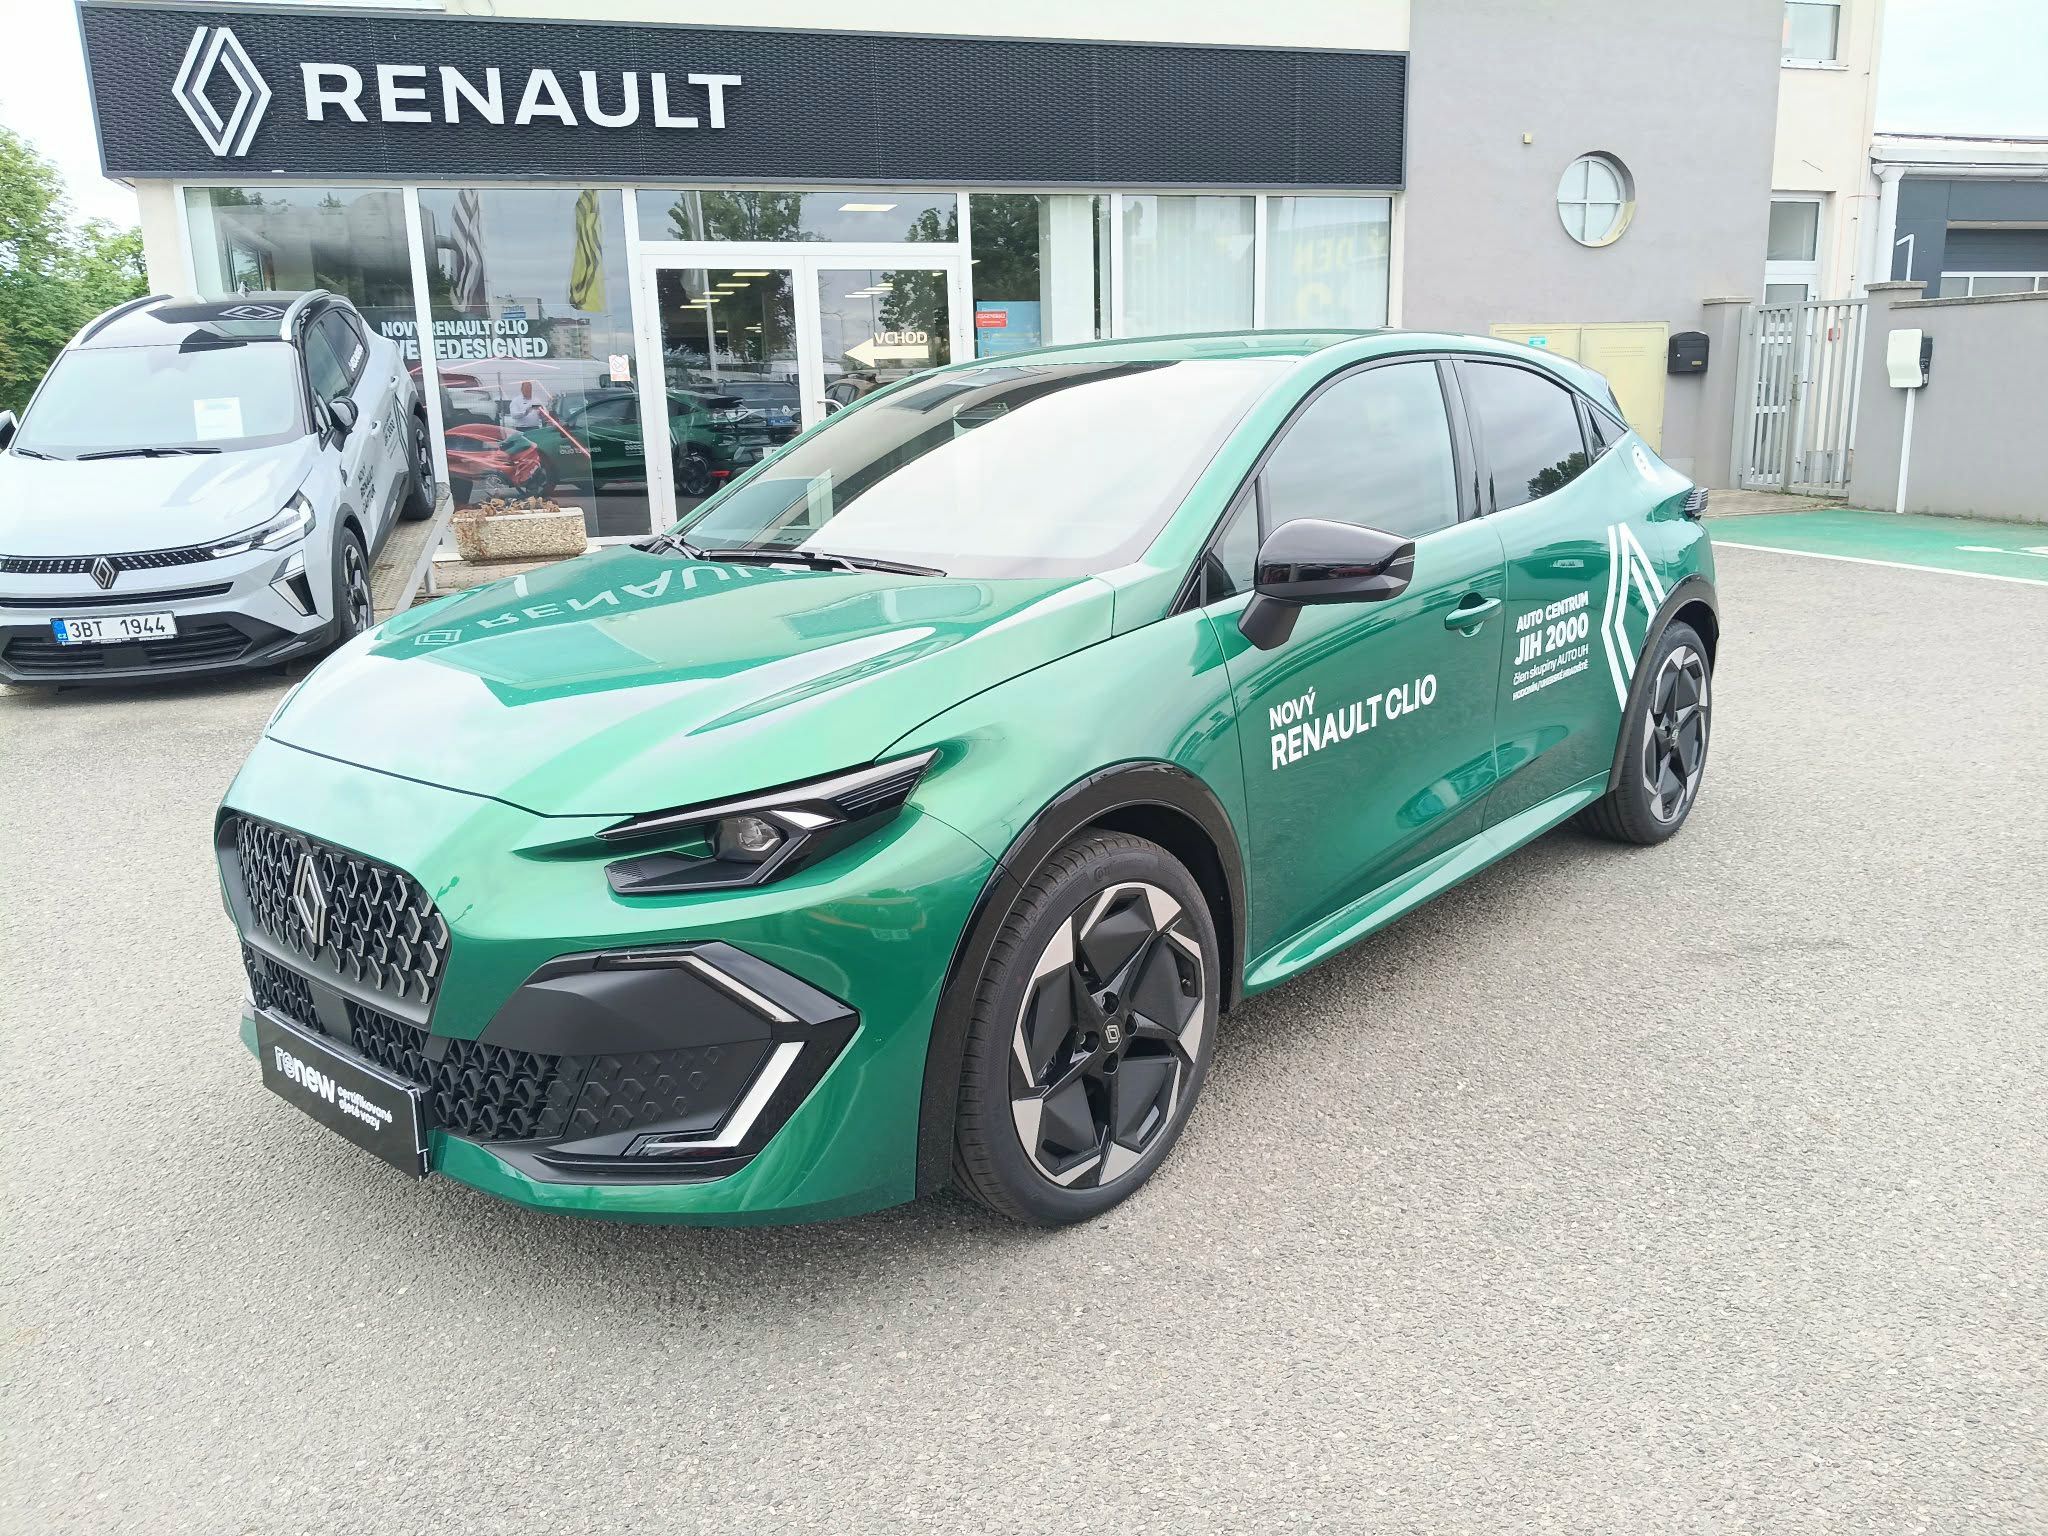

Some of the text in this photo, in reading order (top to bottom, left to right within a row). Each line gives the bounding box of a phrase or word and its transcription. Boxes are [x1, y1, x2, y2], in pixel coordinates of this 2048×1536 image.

[300, 62, 742, 129] RENAULT
[434, 337, 548, 360] EDESIGNED
[494, 319, 529, 335] CLIO
[874, 331, 928, 345] VCHOD
[70, 617, 165, 638] 3BT 1944
[1516, 590, 1589, 633] AUTO CENTRUM
[1514, 612, 1589, 666] JIH 2000
[1557, 648, 1578, 666] AUTO
[1269, 686, 1316, 730] NOVÝ
[1271, 674, 1437, 770] RENAULT CLIO
[274, 1046, 335, 1104] renew
